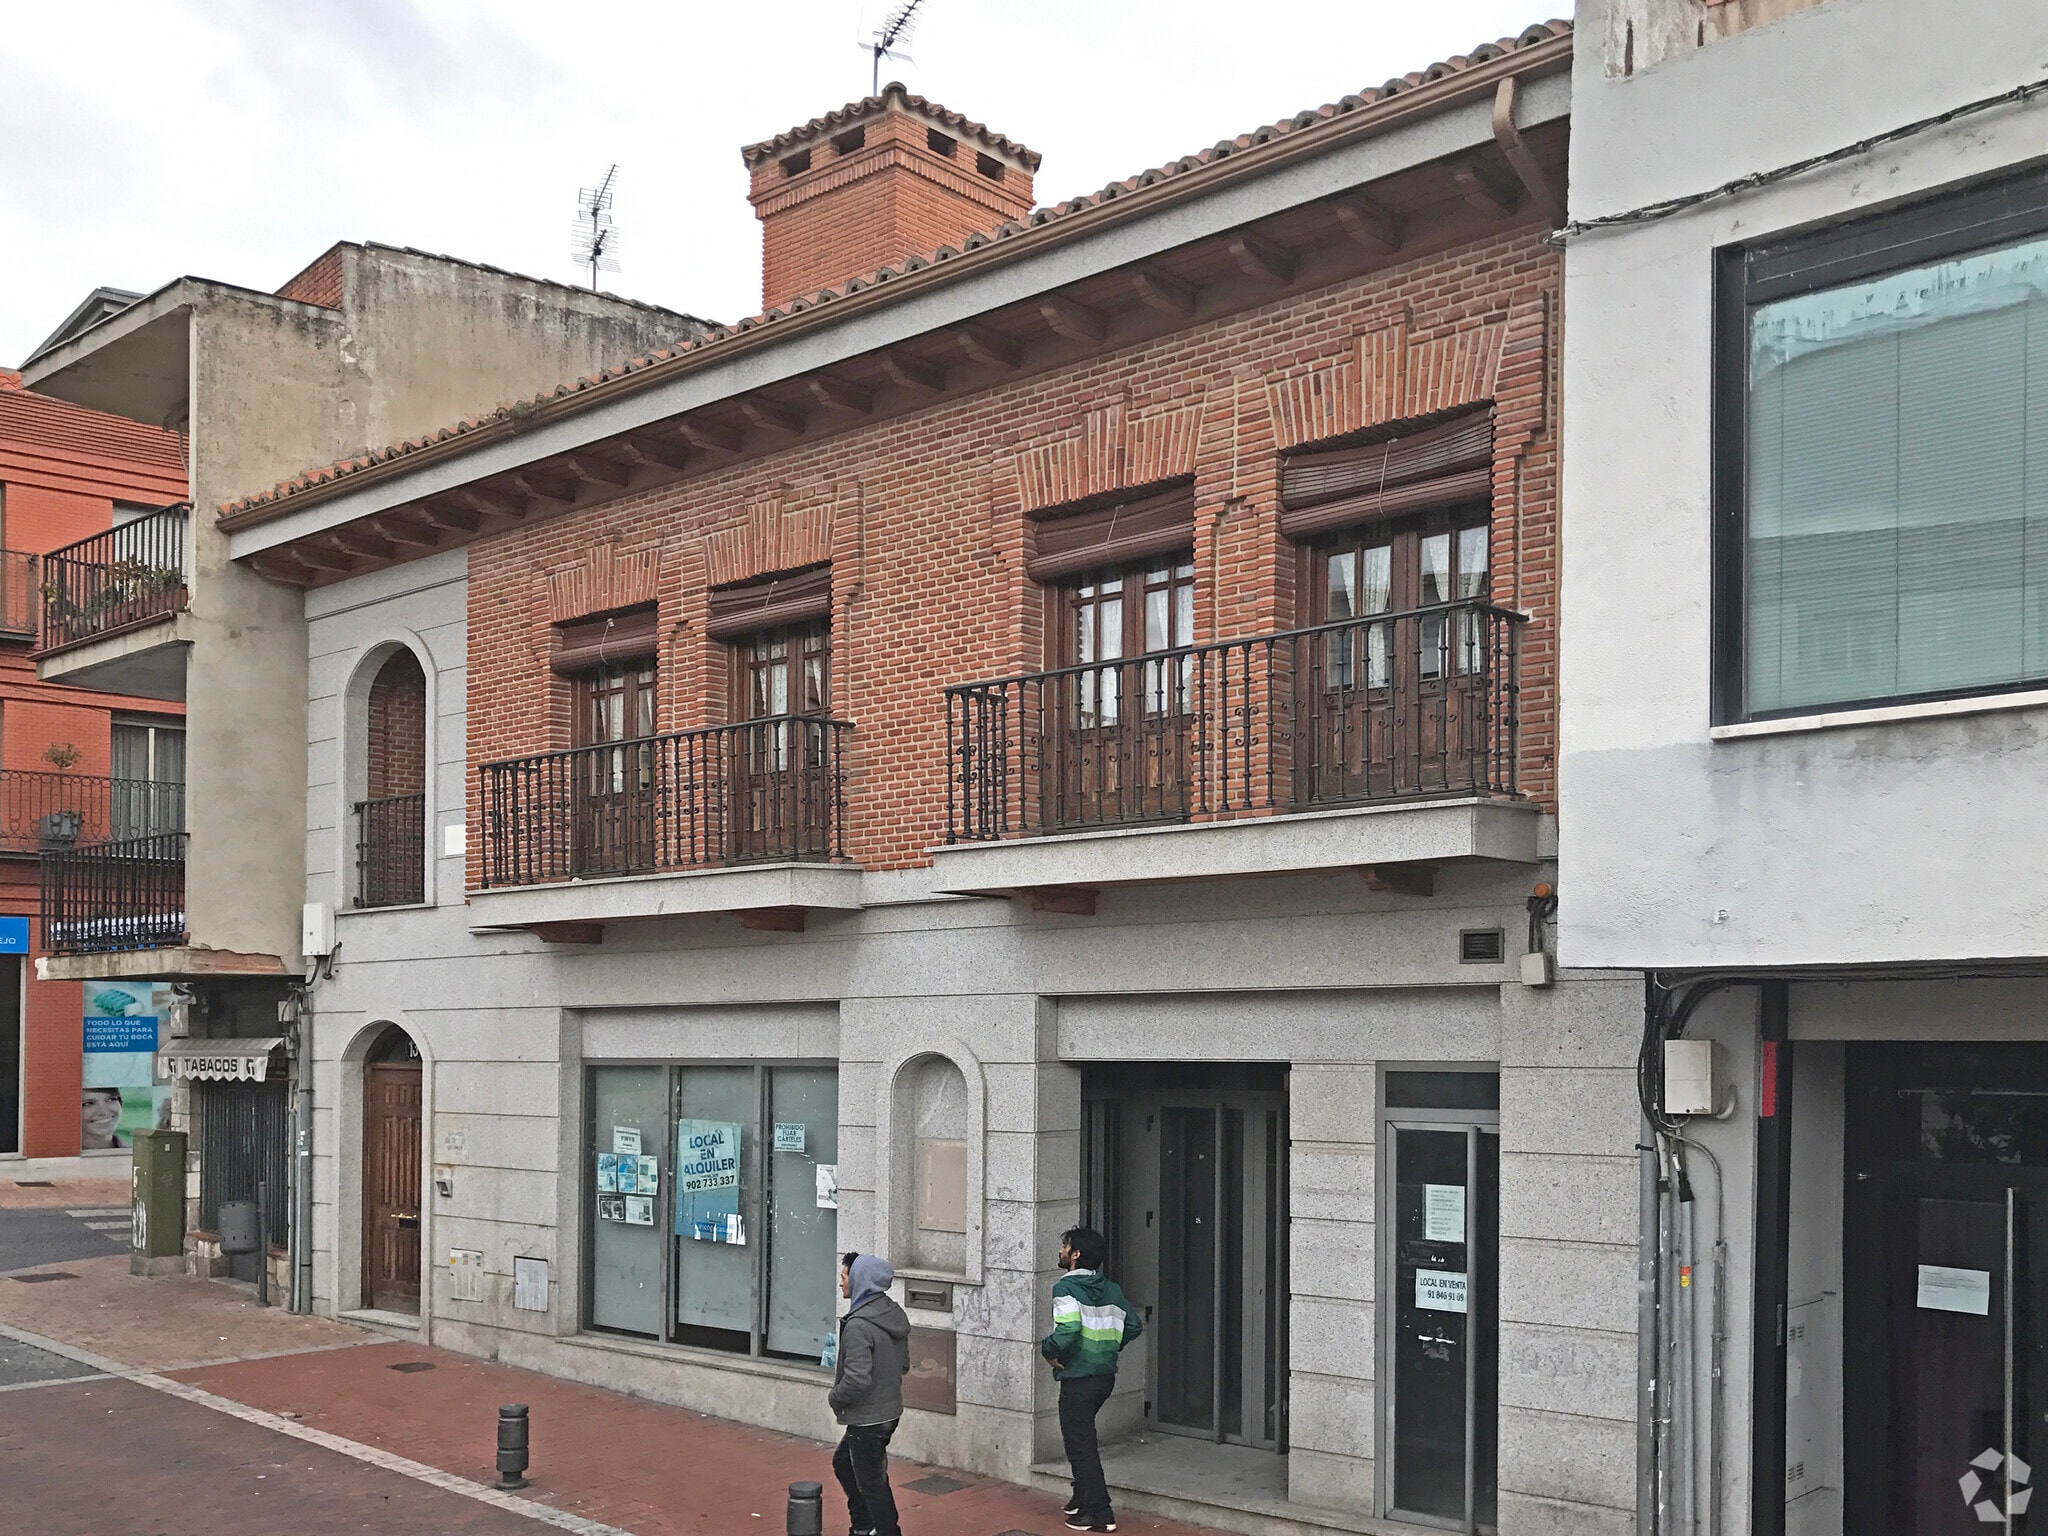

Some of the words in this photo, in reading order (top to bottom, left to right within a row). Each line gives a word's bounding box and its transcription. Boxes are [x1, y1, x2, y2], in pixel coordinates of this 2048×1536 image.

[184, 1058, 238, 1072] TABACOS
[775, 1123, 804, 1131] PROHIBIDO
[689, 1132, 724, 1149] LOCAL
[777, 1135, 802, 1143] CARTELES
[700, 1147, 715, 1160] EN
[683, 1158, 735, 1175] ALQUILER
[686, 1180, 702, 1190] 902
[703, 1177, 719, 1188] 733
[720, 1175, 735, 1185] 337
[1420, 1277, 1438, 1288] LOCAL
[1439, 1279, 1448, 1288] EN
[1448, 1280, 1467, 1290] VENTA
[1427, 1290, 1435, 1299] 91
[1448, 1292, 1456, 1301] 91
[1456, 1293, 1465, 1302] 09
